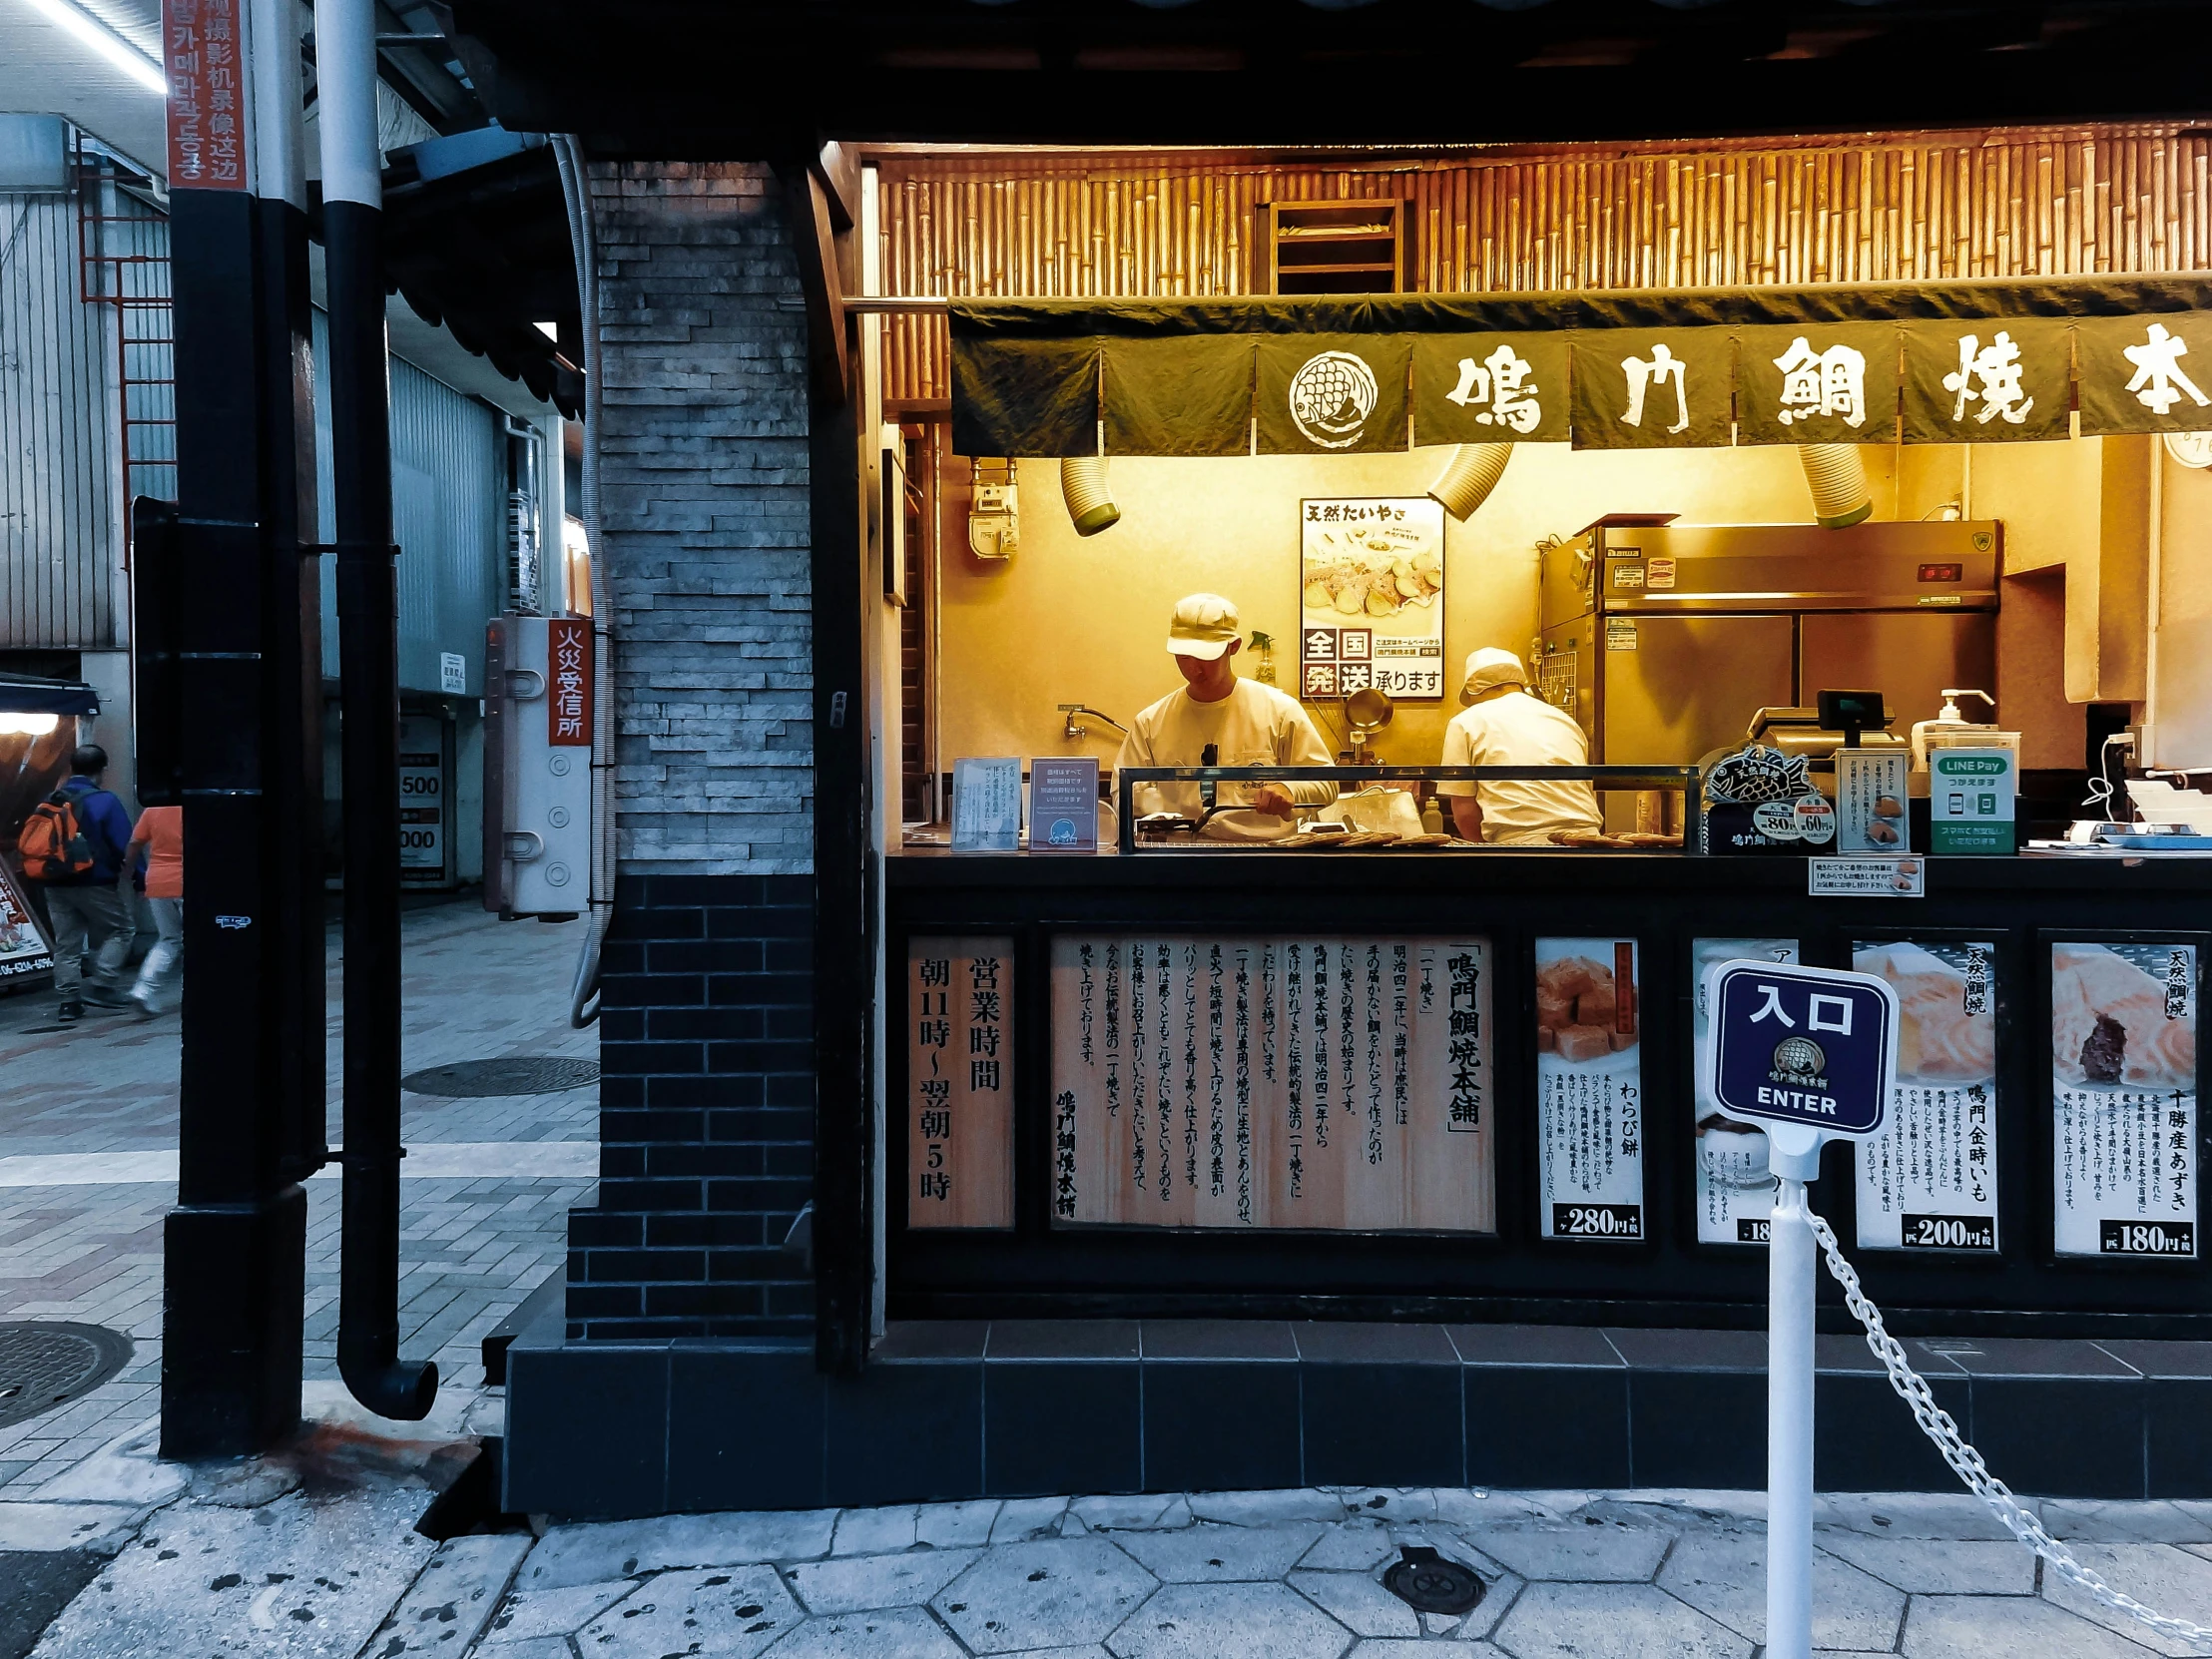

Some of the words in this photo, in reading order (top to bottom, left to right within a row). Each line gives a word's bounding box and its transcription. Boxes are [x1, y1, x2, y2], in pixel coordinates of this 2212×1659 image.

[556, 626, 584, 739] 火災受信所
[1306, 631, 1372, 658] 全国
[1306, 665, 1371, 694] 発送
[1376, 670, 1440, 692] 承ります
[402, 776, 439, 795] 500
[1946, 761, 1975, 772] LINE
[1976, 761, 2000, 772] Pay
[1947, 778, 1996, 787] つかえます
[969, 957, 1001, 1092] 営業時間
[1079, 943, 1095, 1066] 焼き上げております。
[1105, 943, 1121, 1117] 今なお伝統製法の一丁焼きで
[1261, 943, 1277, 1084] こだわりを持っています。
[1340, 944, 1356, 1116] たい焼きの歴史の始まりです。
[1418, 948, 1435, 1014] 「一丁焼き」
[1447, 944, 1482, 1133] 「鳴門鯛焼本舗」
[1749, 984, 1854, 1036] 入口
[1966, 947, 1987, 1014] 天然鯛焼
[2168, 950, 2188, 1017] 天然鯛焼
[1157, 943, 1172, 1202] 効率は悪くともこれぞたい焼きというものを
[1183, 943, 1199, 1190] パリッとしてとても香り高く仕上がります。
[1209, 943, 1225, 1198] 直火で短時間に焼き上げるため皮の表面が
[1288, 943, 1304, 1199] 受け継がれてきた伝統的製法の一丁焼きに
[1313, 944, 1329, 1148] 鳴門鯛焼本舗では明治四二年から
[1367, 944, 1382, 1165] 手の届かない鯛をかたどって作ったのが
[1757, 1086, 1838, 1115] ENTER
[1056, 1090, 1077, 1219] 鳴門鯛焼本舗
[1619, 1081, 1639, 1158] わらび餅
[1966, 1083, 1988, 1203] 鳴門金時いも
[2167, 1089, 2189, 1211] 十勝産あずき
[1569, 1208, 1628, 1235] 280円
[1919, 1219, 1980, 1247] 200円
[2119, 1225, 2179, 1253] 180円
